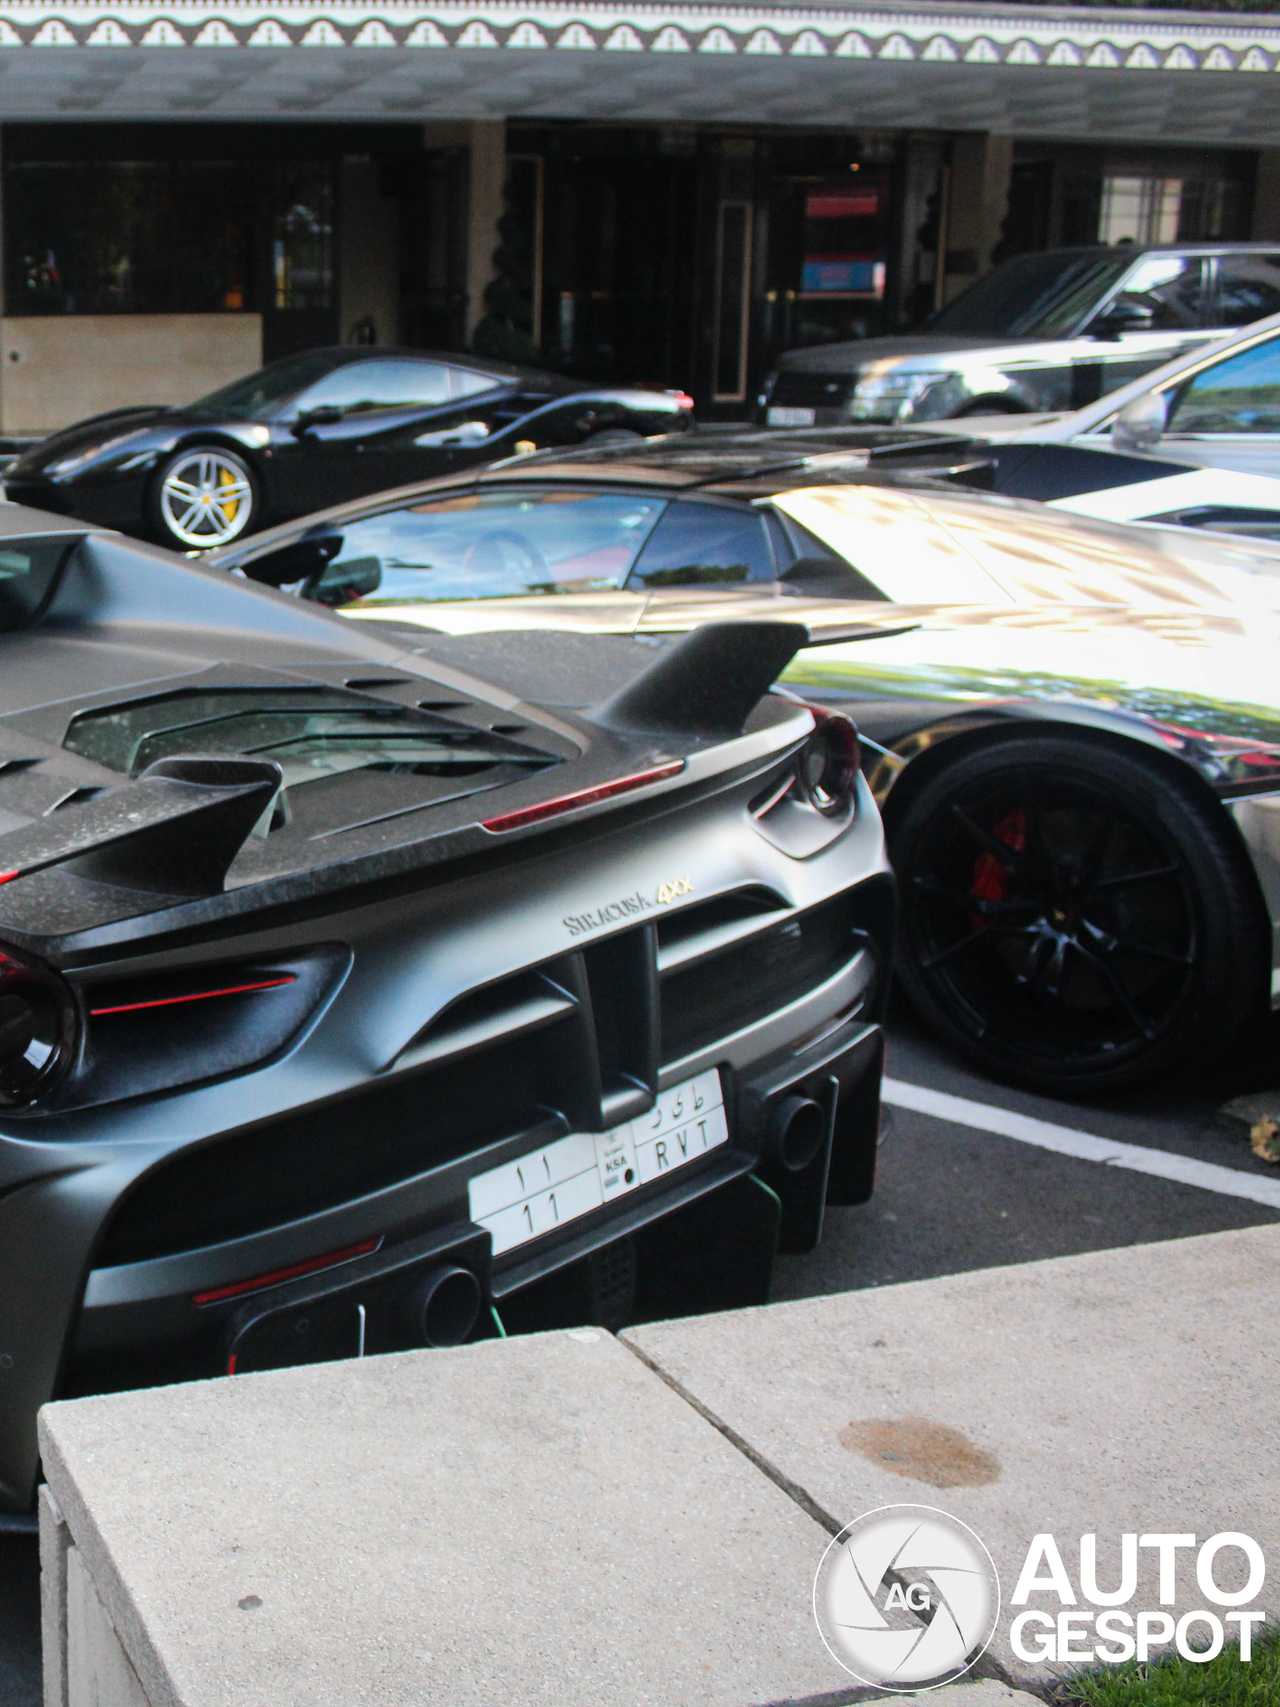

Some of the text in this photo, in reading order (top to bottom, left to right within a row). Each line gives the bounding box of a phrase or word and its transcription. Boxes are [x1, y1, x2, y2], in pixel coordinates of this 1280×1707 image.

[562, 874, 695, 936] SIRACUSA 4XX
[605, 1155, 628, 1172] KSA
[523, 1192, 559, 1233] 11
